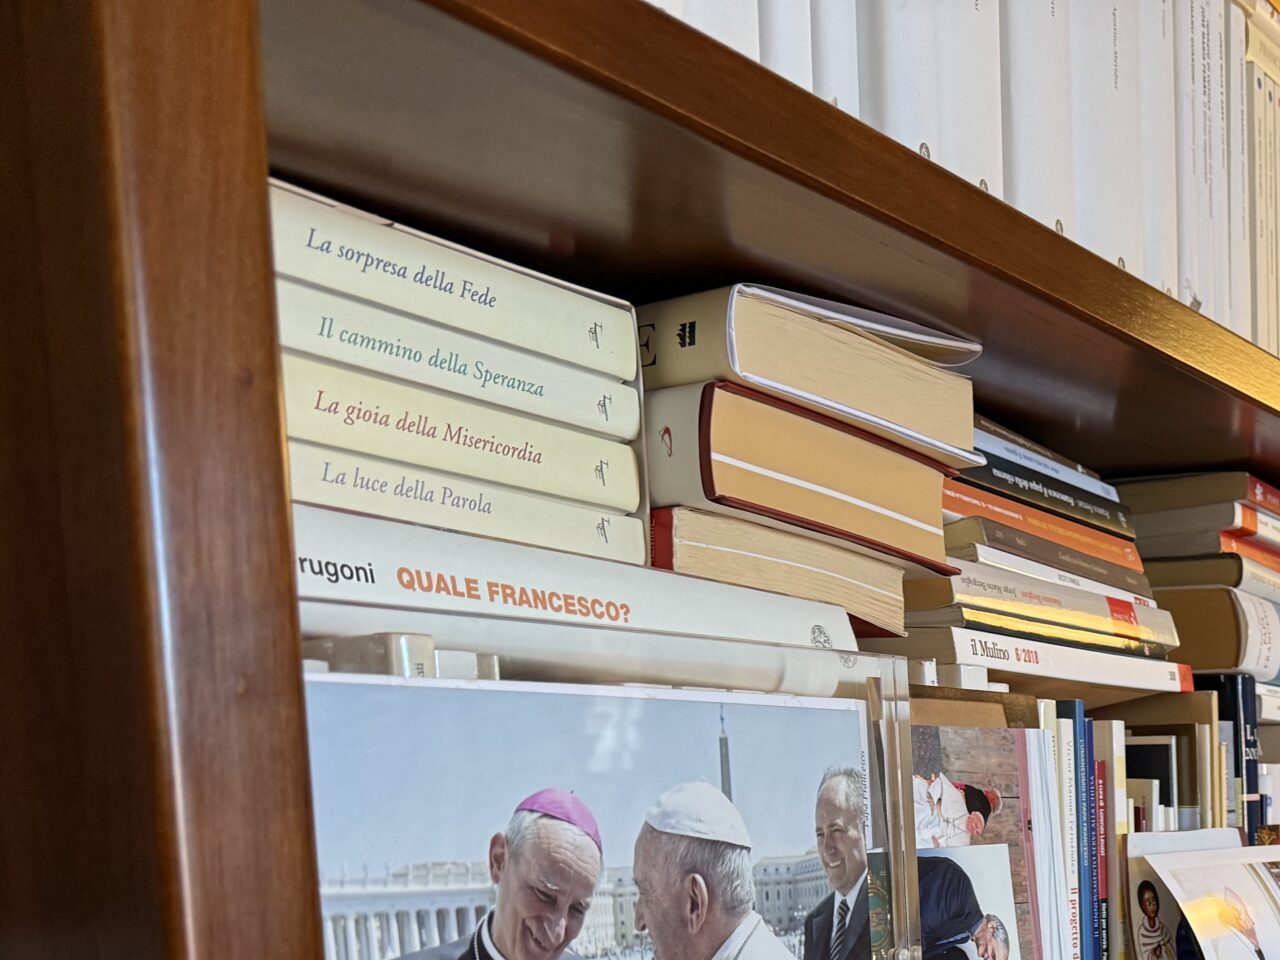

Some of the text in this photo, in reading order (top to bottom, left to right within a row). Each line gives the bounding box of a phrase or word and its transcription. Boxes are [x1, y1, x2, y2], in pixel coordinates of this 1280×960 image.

[306, 227, 497, 308] La sorpresa della Fede
[318, 316, 545, 398] Il cammino della Speranza
[314, 390, 543, 465] La gioia della Misericordia
[321, 461, 493, 515] La luce della Parola
[298, 555, 631, 624] rugoni QUALE FRANCESCO?
[970, 638, 979, 654] il
[978, 639, 1010, 661] Mulino
[1069, 898, 1079, 949] progetto
[1091, 856, 1099, 927] RINNOVAMENTO
